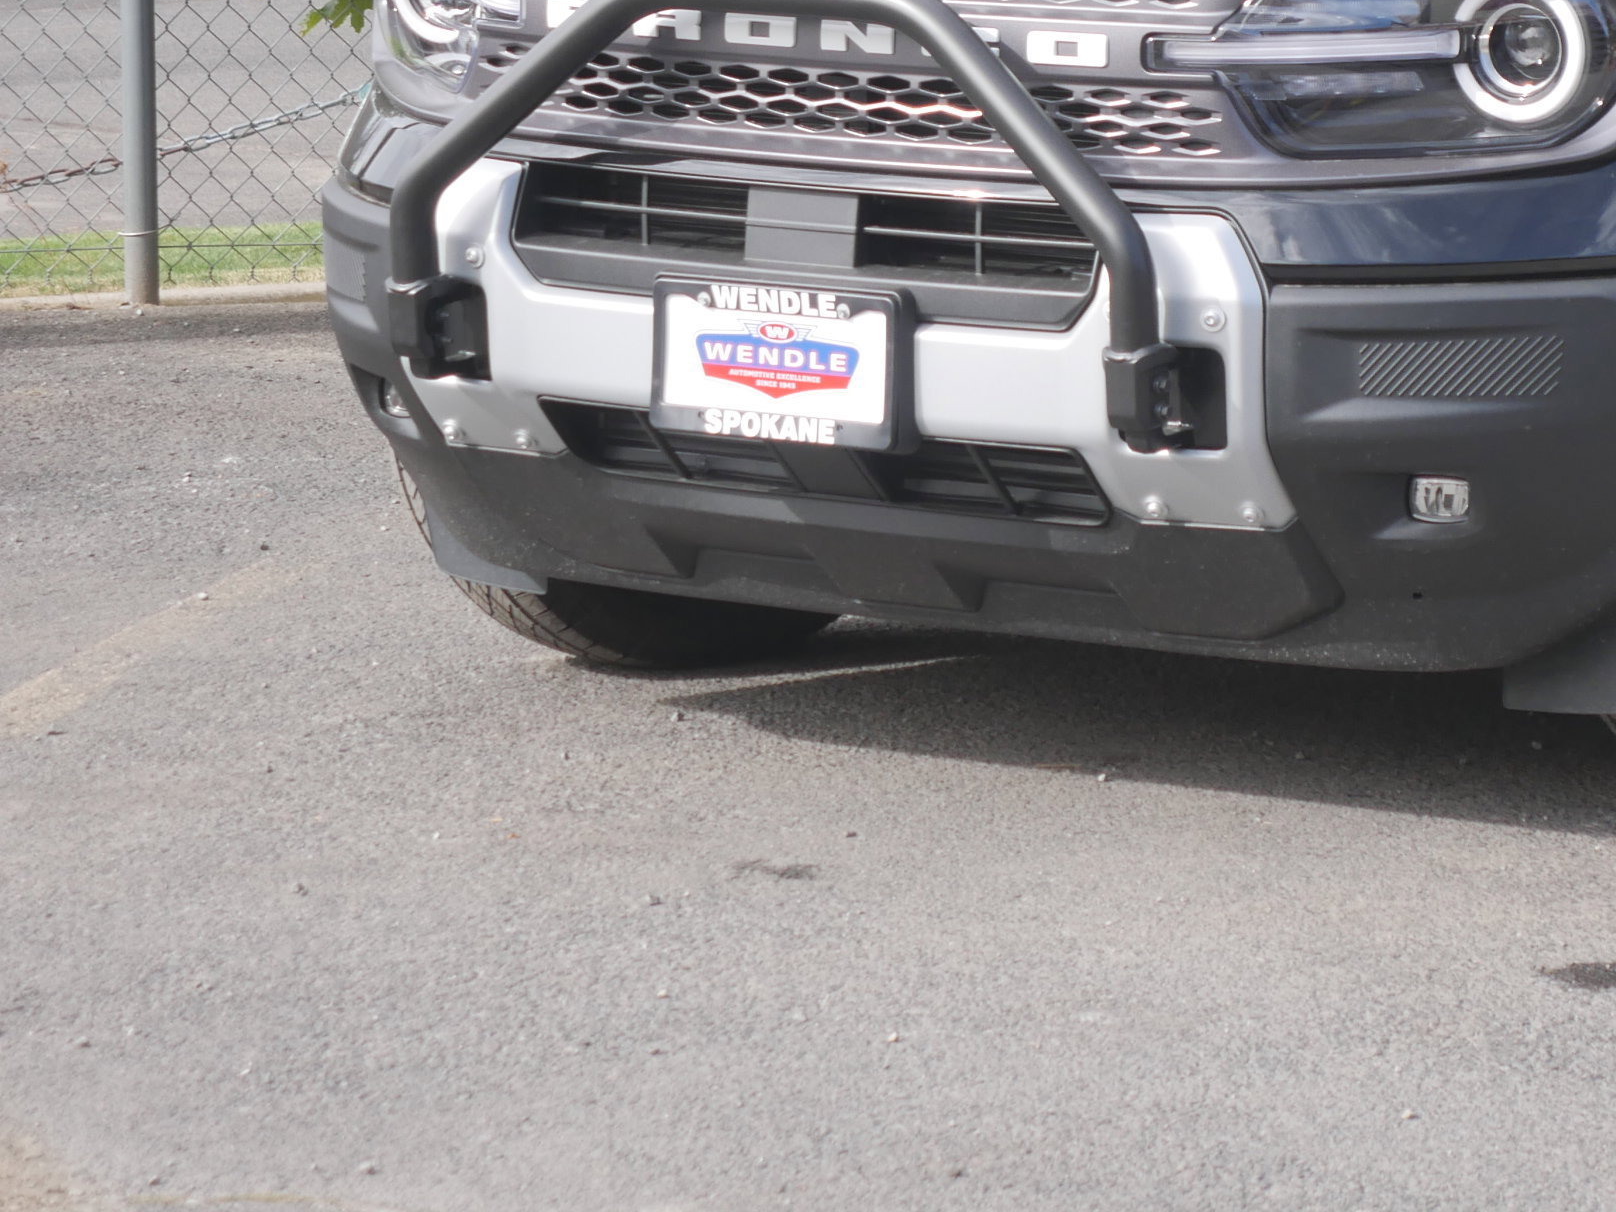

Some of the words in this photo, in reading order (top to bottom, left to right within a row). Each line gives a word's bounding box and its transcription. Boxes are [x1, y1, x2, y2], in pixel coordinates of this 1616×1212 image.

[710, 284, 838, 319] WENDLE
[703, 341, 848, 373] WENDLE
[728, 368, 775, 380] AUTOMOTIVE
[775, 372, 822, 384] EXCELLENCE
[755, 379, 778, 388] SINCE
[704, 408, 836, 446] SPOKANE
